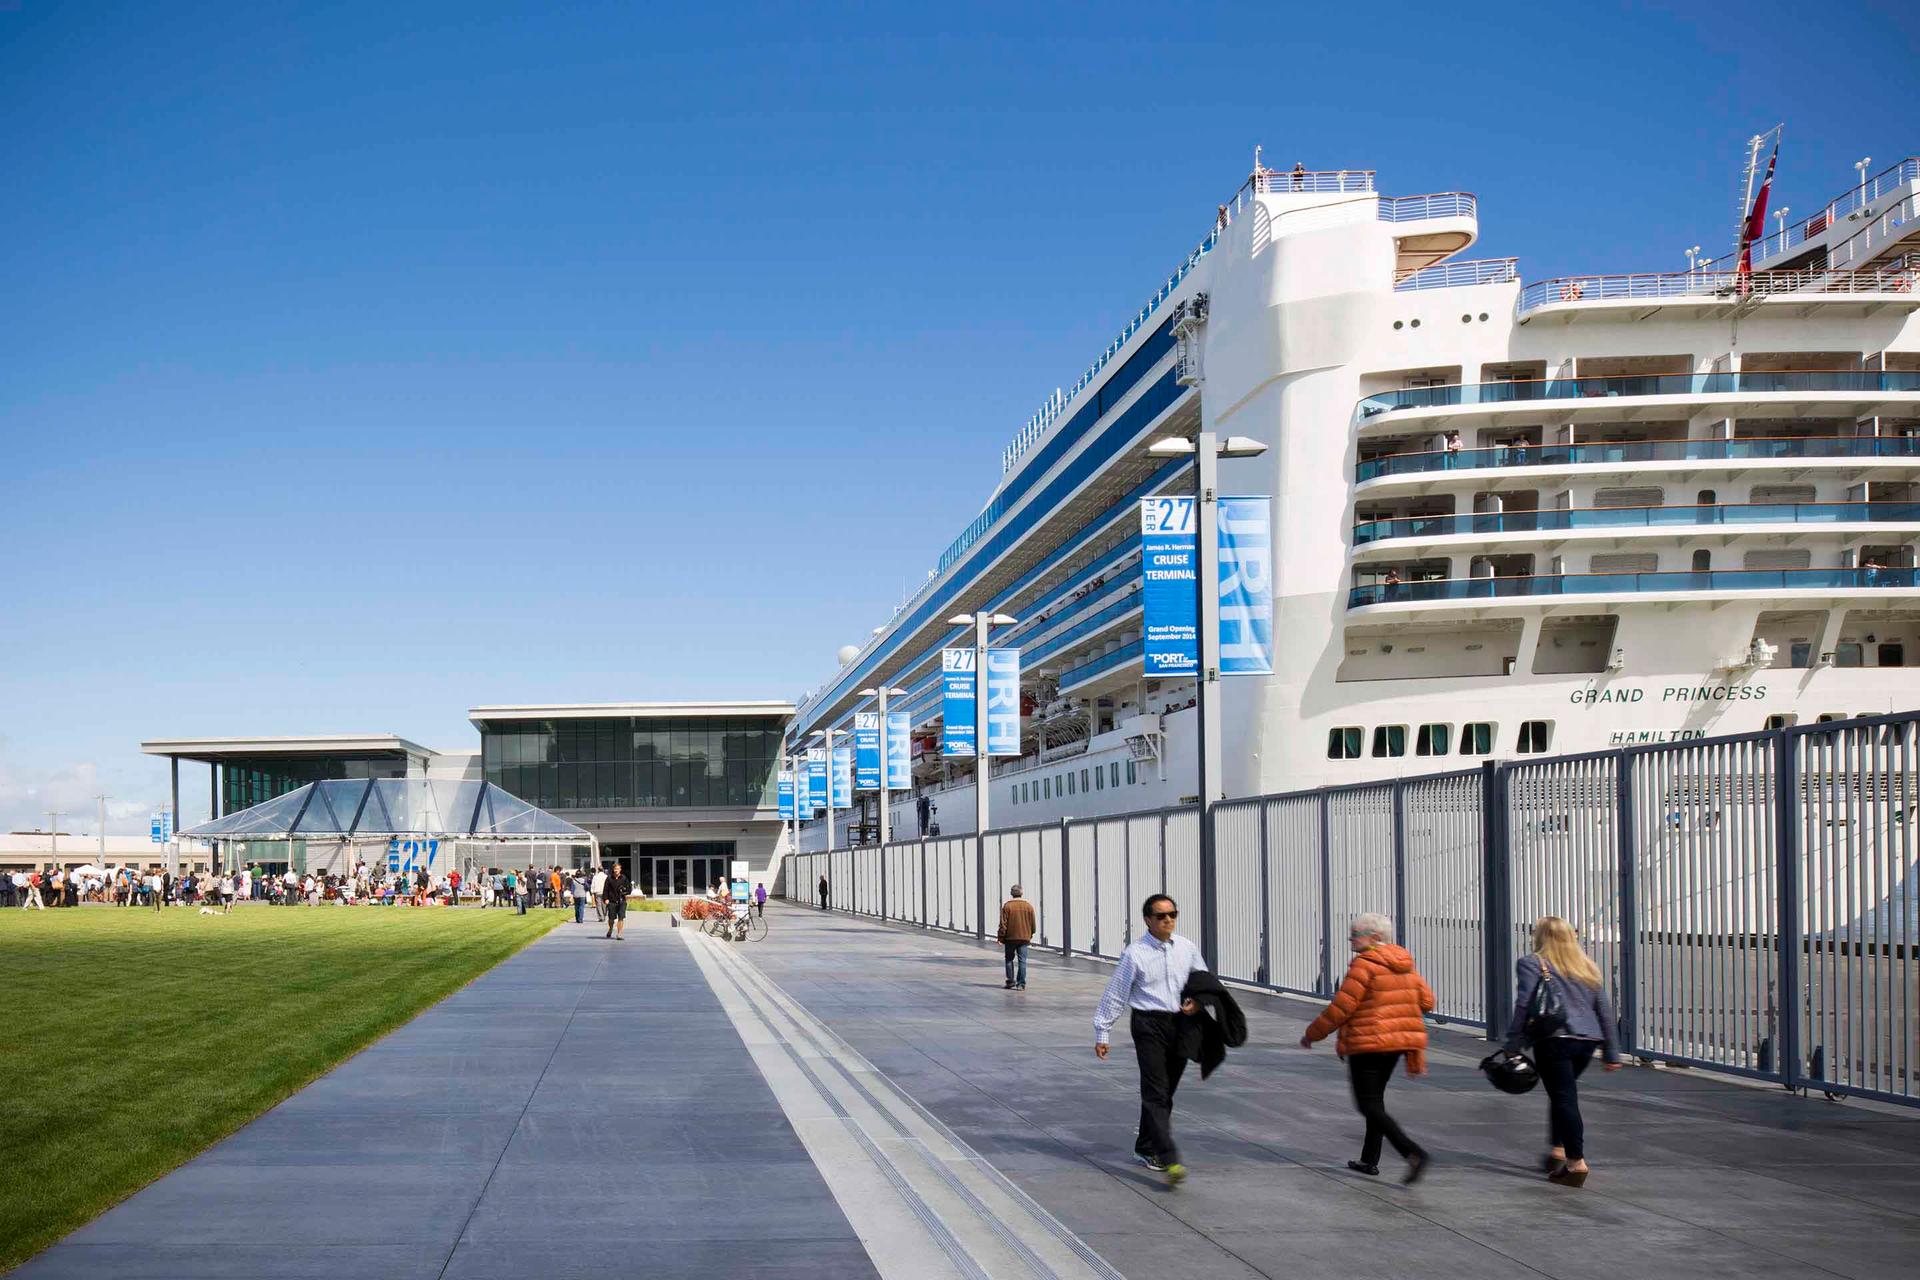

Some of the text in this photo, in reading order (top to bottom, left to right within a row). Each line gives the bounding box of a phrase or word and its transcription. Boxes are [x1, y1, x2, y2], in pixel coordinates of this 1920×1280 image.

[1146, 499, 1155, 531] PIER
[1159, 499, 1193, 531] 27
[1153, 554, 1189, 565] CRUISE
[1145, 569, 1197, 580] TERMINAL
[1169, 625, 1196, 633] Opening
[1148, 633, 1181, 641] September
[954, 650, 973, 670] 27
[1149, 653, 1184, 664] PORT
[1570, 686, 1768, 703] GRAND PRINCESS
[863, 714, 877, 728] 27
[1611, 729, 1706, 744] HAMILTON
[813, 750, 825, 760] 27
[403, 839, 438, 872] 27
